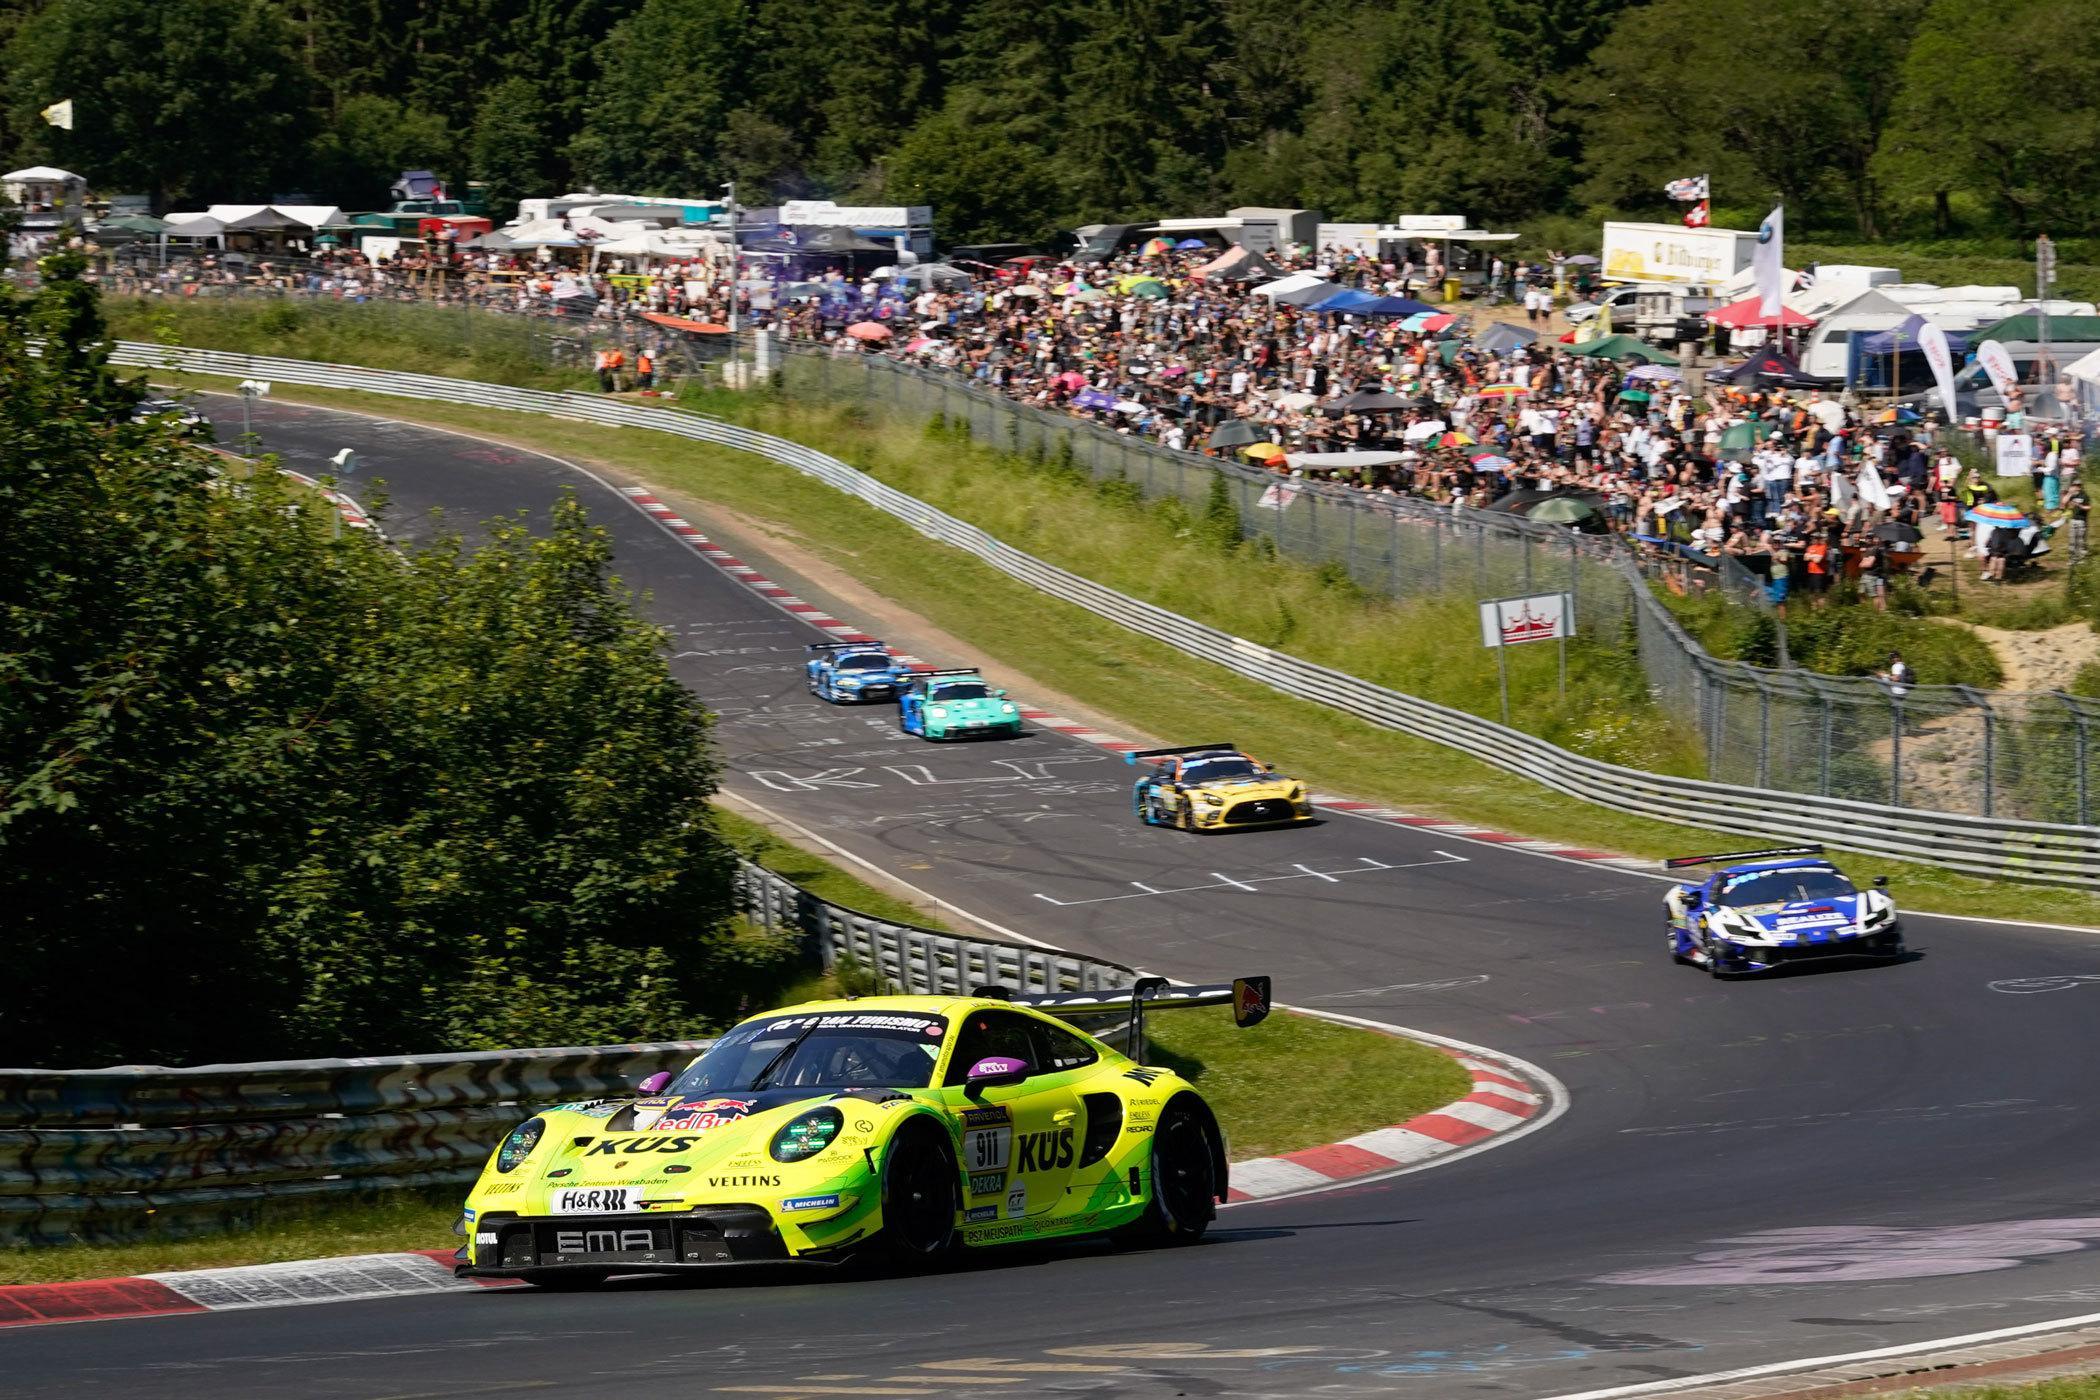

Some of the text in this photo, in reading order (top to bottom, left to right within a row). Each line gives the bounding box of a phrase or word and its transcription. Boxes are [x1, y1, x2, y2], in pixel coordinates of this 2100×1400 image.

[856, 1016, 931, 1029] TURISMO
[969, 1111, 1007, 1123] RAVENOL
[1126, 1125, 1153, 1133] RECARO
[585, 1136, 702, 1156] KÜS
[976, 1130, 999, 1168] 911
[1017, 1127, 1074, 1174] KÜS
[618, 1178, 668, 1186] Wiesbaden
[709, 1175, 781, 1188] VELTINS
[971, 1174, 1002, 1194] DEKRA
[484, 1182, 524, 1196] VELTINS
[562, 1190, 600, 1210] H&R
[794, 1198, 835, 1208] MICHELIN
[476, 1232, 498, 1245] MOTUL
[556, 1229, 654, 1253] EMA
